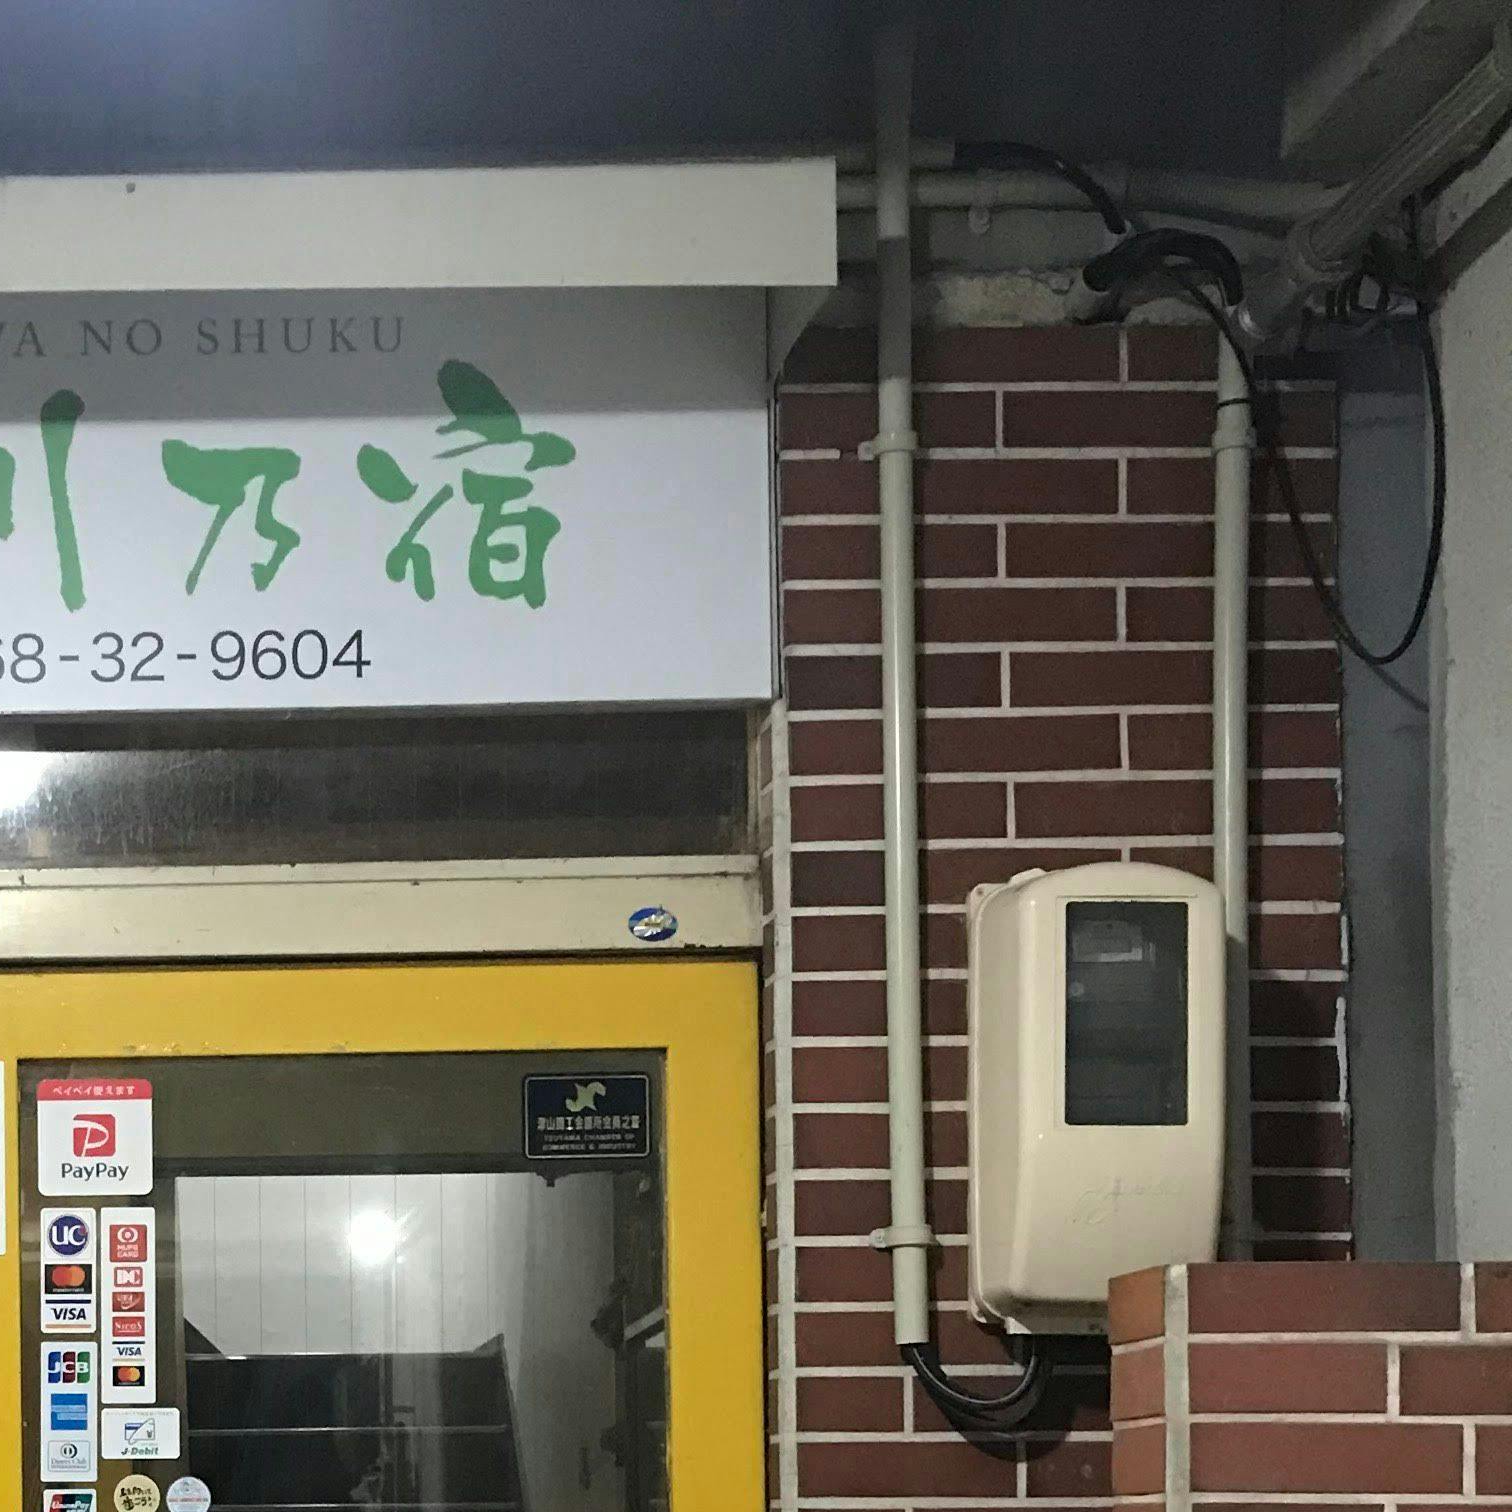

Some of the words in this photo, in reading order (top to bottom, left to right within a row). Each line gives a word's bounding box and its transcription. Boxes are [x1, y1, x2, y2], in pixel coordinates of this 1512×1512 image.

[80, 319, 165, 357] NO
[195, 314, 408, 357] SHUKU
[61, 1163, 129, 1181] PayPay
[52, 1225, 87, 1245] UC
[51, 1308, 86, 1321] VISA
[116, 1347, 142, 1356] VISA
